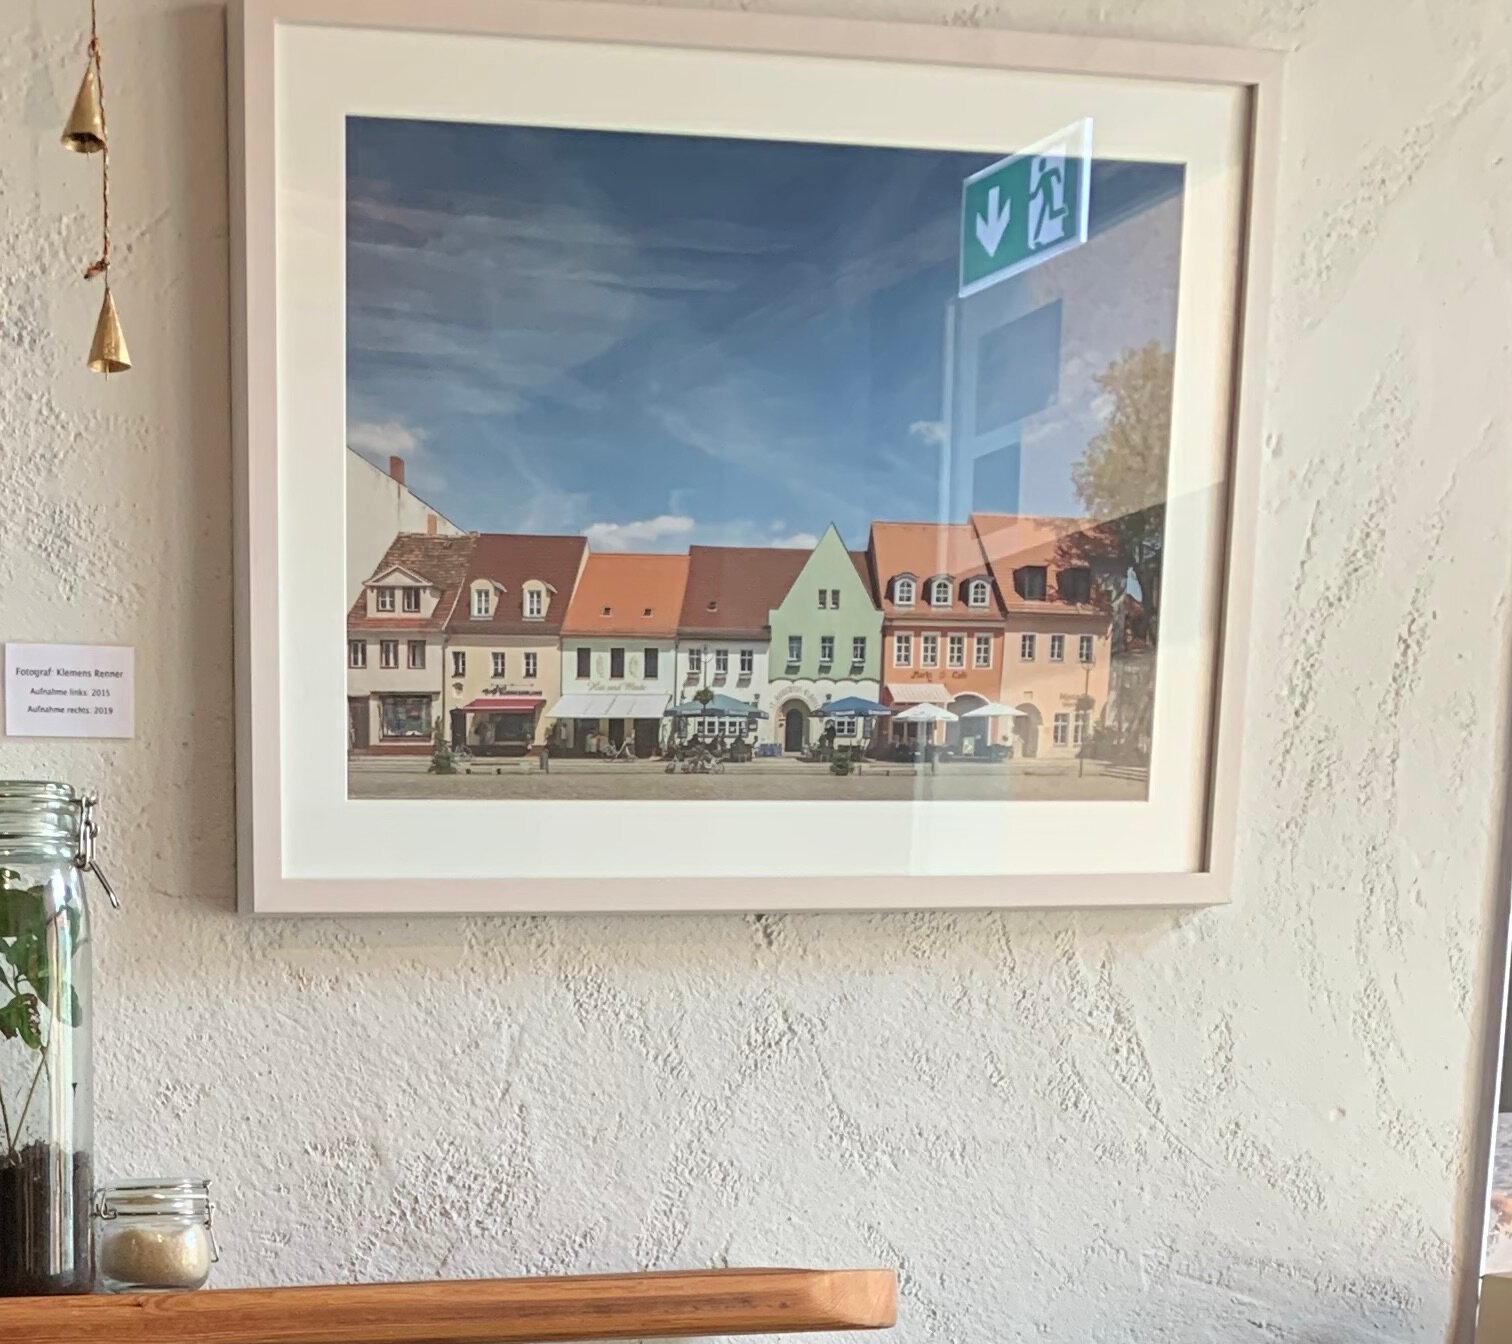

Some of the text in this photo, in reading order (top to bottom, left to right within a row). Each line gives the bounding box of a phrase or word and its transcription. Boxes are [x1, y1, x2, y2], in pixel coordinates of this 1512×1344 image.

[56, 668, 92, 678] Klemens
[30, 687, 67, 696] Aufnahme
[91, 689, 111, 697] 2015
[27, 705, 65, 714] Aufnahme
[93, 706, 114, 715] 2019
